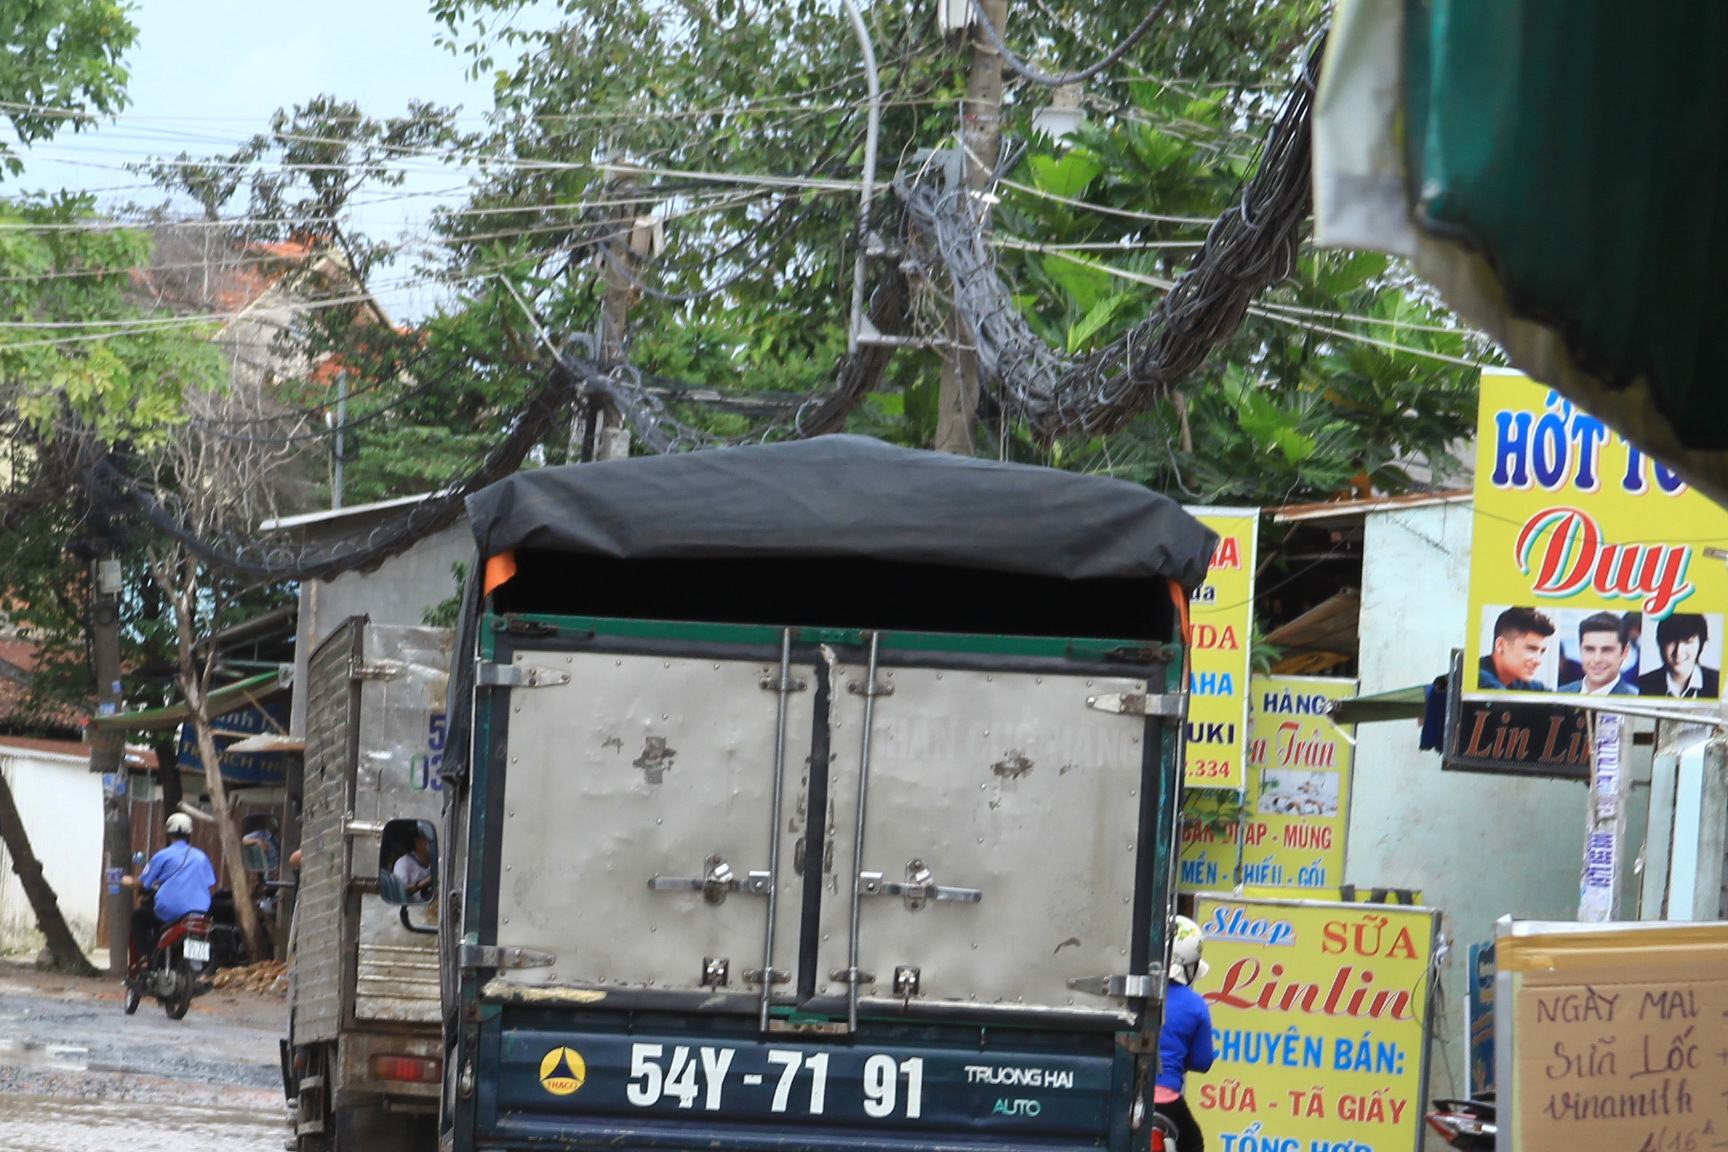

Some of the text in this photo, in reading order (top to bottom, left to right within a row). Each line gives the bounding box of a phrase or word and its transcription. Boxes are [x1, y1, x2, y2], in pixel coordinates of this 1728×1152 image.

[1491, 389, 1606, 489] HỚT
[1515, 506, 1695, 619] Duy
[1464, 711, 1530, 760] Lin
[1203, 905, 1420, 960] Shop SỮA
[1201, 957, 1416, 1021] Linlin
[1537, 985, 1699, 1023] NGÀY MAI
[964, 1065, 1074, 1090] TRUONG HAI
[1333, 1031, 1405, 1075] BÁN:
[863, 1054, 924, 1119] 91
[991, 1098, 1041, 1117] AUTO
[1199, 1079, 1257, 1112] SỮA
[1288, 1086, 1325, 1119] TÃ
[1337, 1087, 1408, 1124] GIẤY
